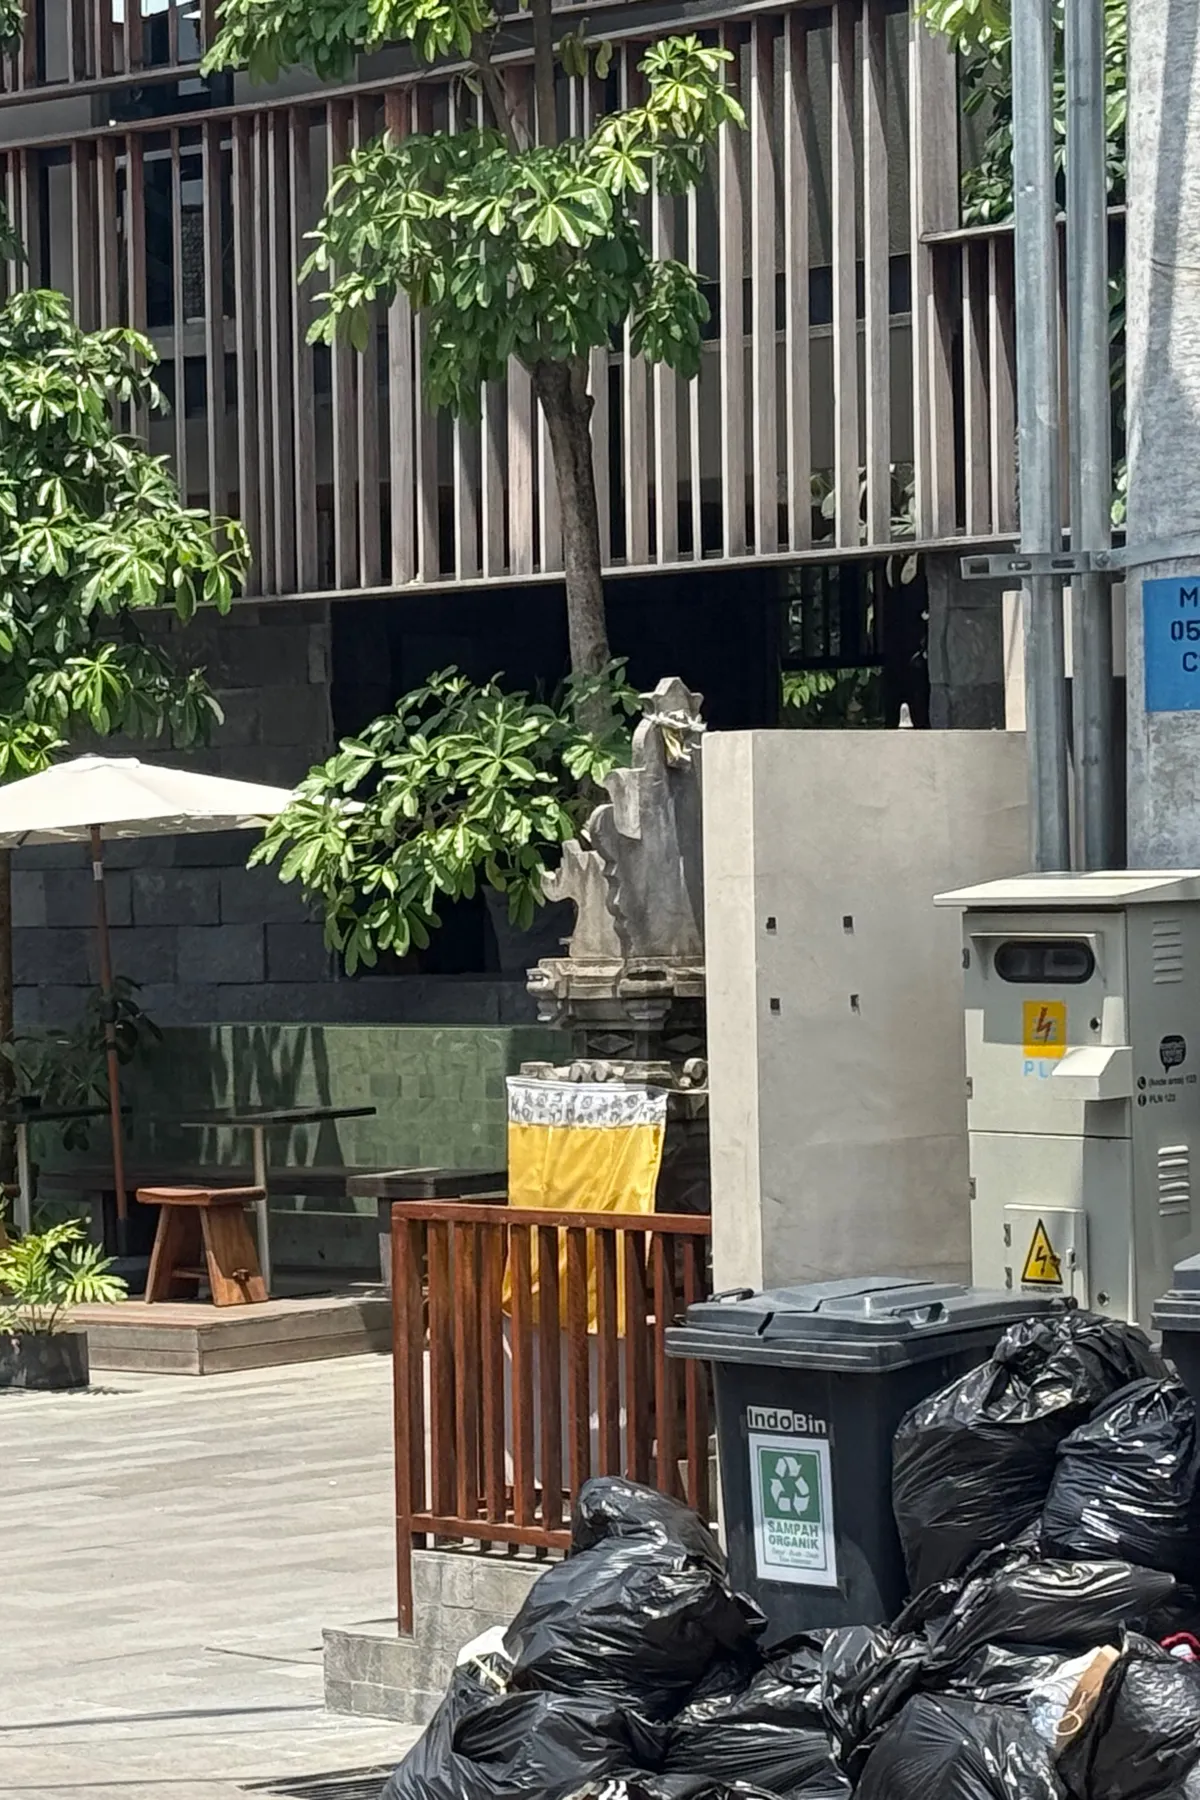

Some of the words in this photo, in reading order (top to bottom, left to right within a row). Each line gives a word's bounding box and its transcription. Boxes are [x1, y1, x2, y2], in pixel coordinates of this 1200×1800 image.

[1182, 651, 1200, 673] C
[1023, 1060, 1056, 1078] PL
[748, 1406, 827, 1434] IndoBin
[767, 1520, 819, 1538] SAMPAH
[768, 1535, 820, 1550] ORGANIK
